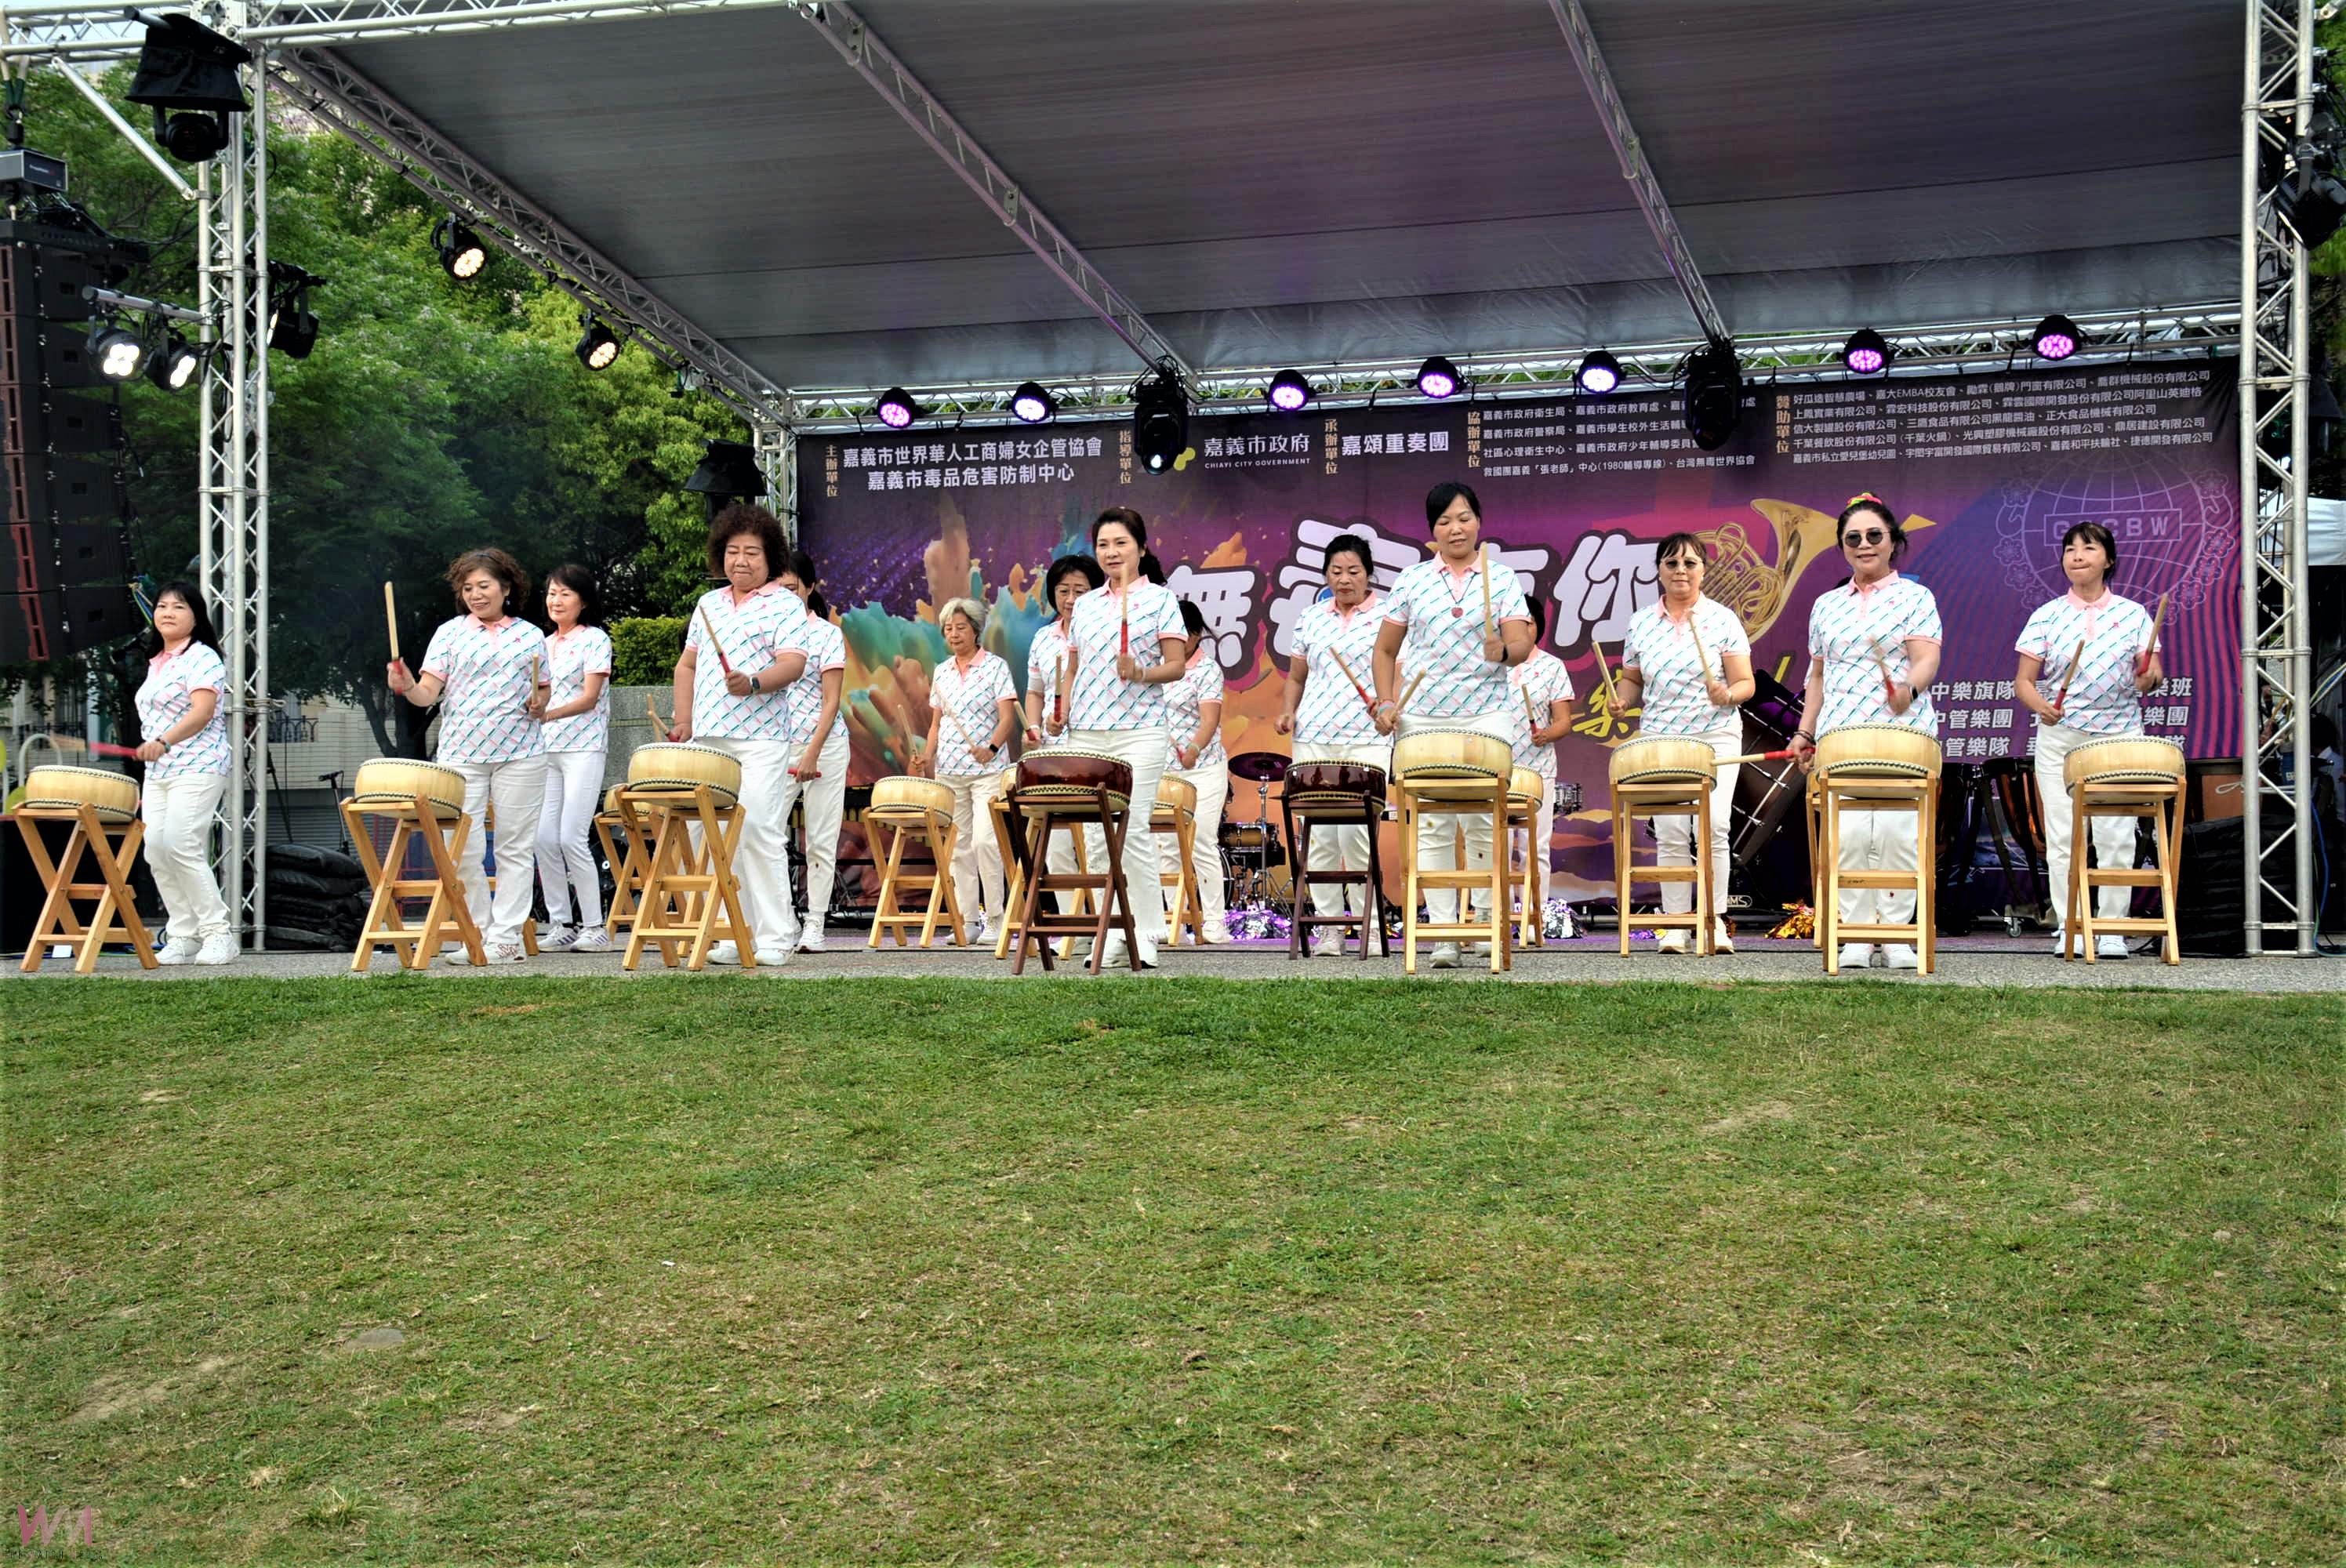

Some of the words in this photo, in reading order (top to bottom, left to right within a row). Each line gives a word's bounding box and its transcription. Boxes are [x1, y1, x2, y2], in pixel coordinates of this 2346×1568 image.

[1467, 412, 1480, 468] 協辦單位
[1776, 395, 1790, 454] 贊助單位
[843, 436, 1102, 468] 嘉義市世界華人工商婦女企管協會
[1119, 430, 1131, 485] 指導單位
[1204, 433, 1310, 457] 嘉義市政府
[1325, 419, 1338, 475] 承辦單位
[1342, 431, 1449, 456] 嘉頌重奏團
[826, 445, 839, 498] 主辦單位
[867, 463, 1075, 491] 嘉義市毒品危害防制中心
[1255, 458, 1310, 467] GOVERNMENT
[2053, 516, 2168, 541] GCBW
